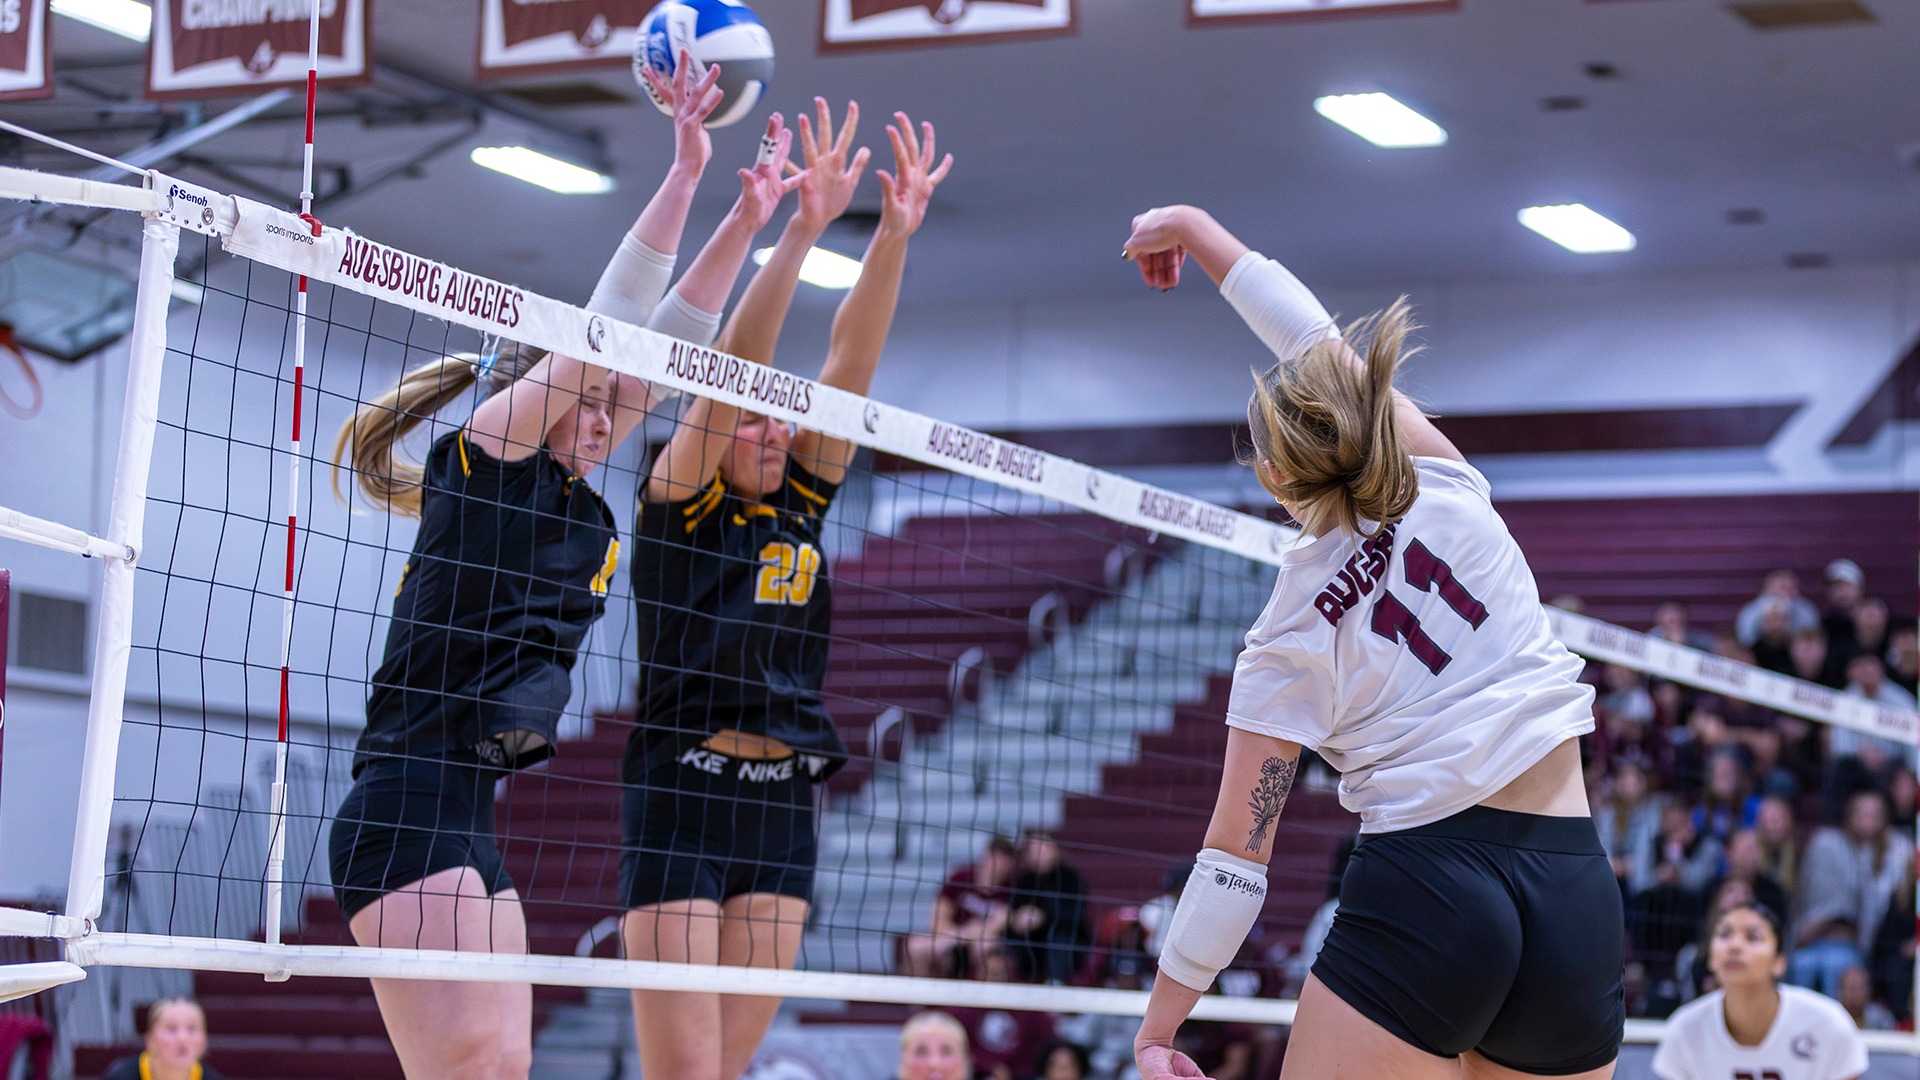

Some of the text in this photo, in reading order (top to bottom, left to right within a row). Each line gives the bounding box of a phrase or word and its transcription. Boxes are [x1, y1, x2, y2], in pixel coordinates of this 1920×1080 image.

[178, 188, 208, 207] Senoh
[338, 236, 524, 328] AUGSBURG AUGGIES
[666, 341, 814, 414] AUGSBURG AUGGIES
[926, 422, 1046, 483] AUGSBURG AUGGIES
[754, 541, 821, 607] 28
[1371, 536, 1490, 677] 11
[675, 747, 729, 776] KE
[737, 760, 794, 783] NIKE
[1216, 868, 1266, 896] Tandem
